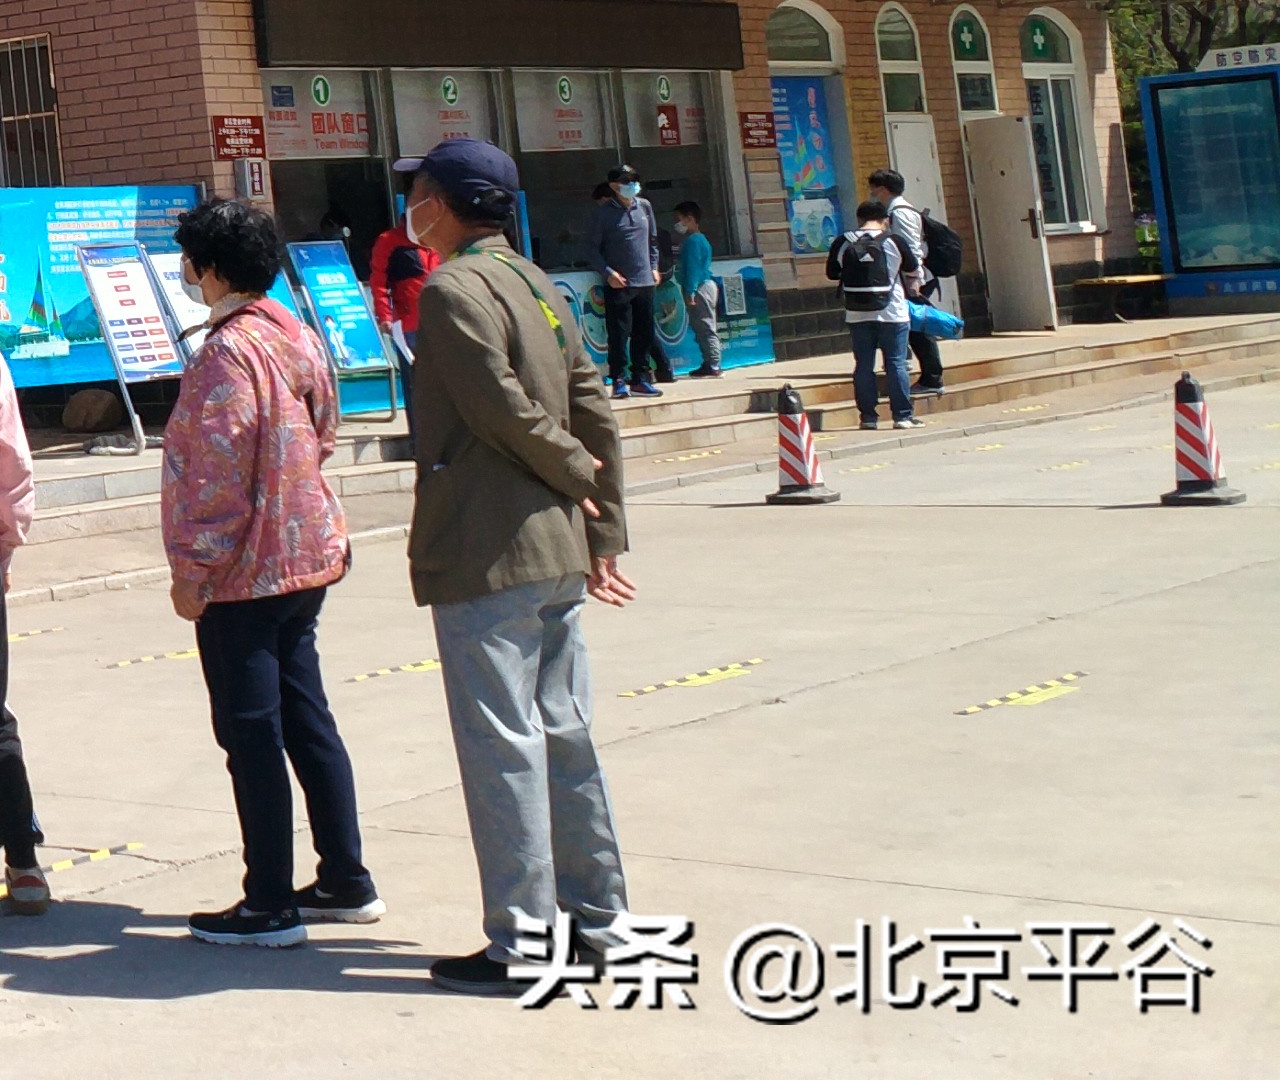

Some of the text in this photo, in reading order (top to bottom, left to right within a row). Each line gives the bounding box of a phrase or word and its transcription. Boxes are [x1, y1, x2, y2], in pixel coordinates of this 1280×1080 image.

[315, 80, 326, 102] 1
[445, 79, 456, 100] 2
[560, 80, 570, 100] 3
[660, 78, 669, 98] 4
[311, 112, 369, 134] 团队窗口
[314, 138, 338, 149] Team
